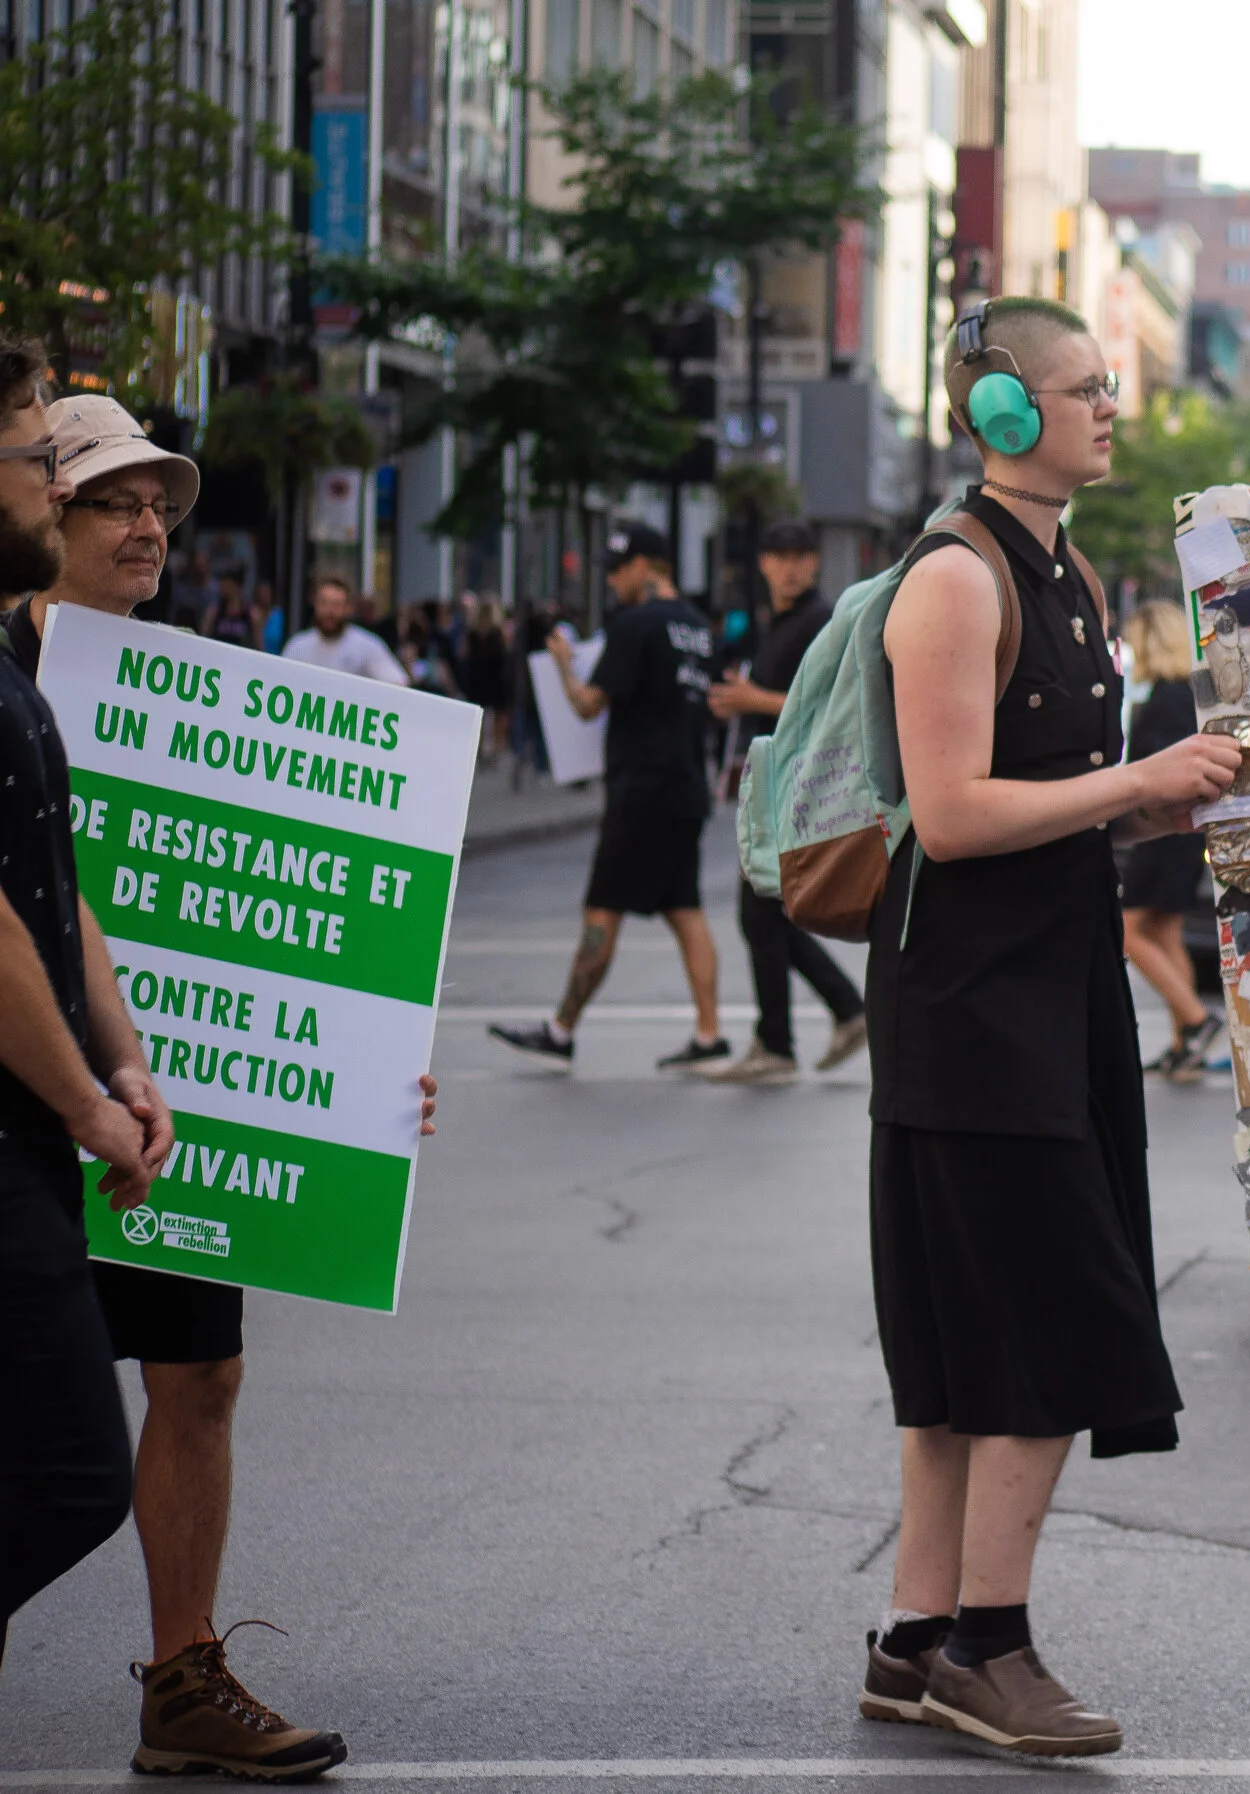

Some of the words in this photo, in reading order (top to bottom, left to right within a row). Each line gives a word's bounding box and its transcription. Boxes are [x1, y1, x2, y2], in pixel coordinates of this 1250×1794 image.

[117, 647, 221, 707] NOUS
[244, 679, 400, 751] SOMMES
[94, 702, 149, 751] UN
[168, 721, 407, 811] MOUVEMENT
[70, 794, 108, 840] DE
[127, 808, 350, 897] RESISTANCE
[369, 864, 412, 909] ET
[112, 866, 160, 914] DE
[179, 881, 345, 955] REVOLTE
[274, 1000, 319, 1047] LA
[136, 1031, 335, 1110] TRUCTION
[163, 1215, 218, 1236] extinction
[178, 1235, 228, 1254] rebellion
